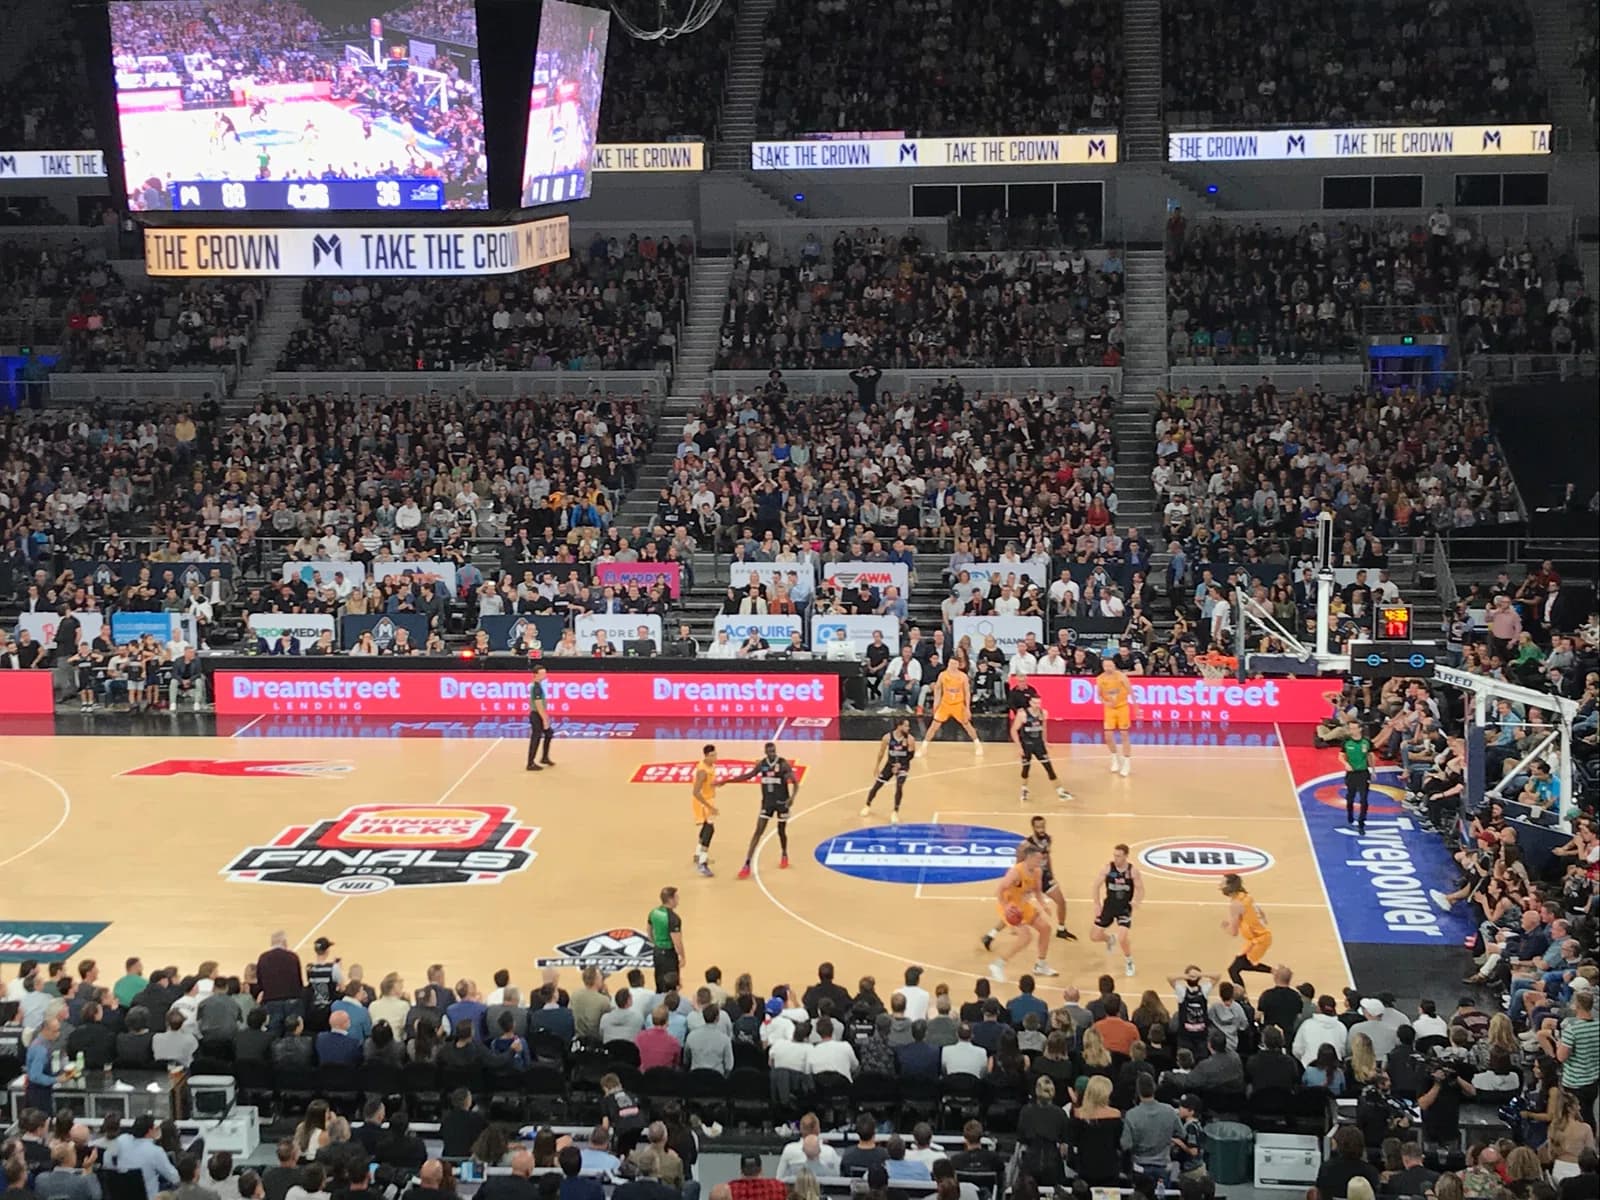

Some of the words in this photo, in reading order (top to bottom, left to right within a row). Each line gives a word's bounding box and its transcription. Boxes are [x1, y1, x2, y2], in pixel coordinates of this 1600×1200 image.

[945, 142, 977, 163] TAKE
[981, 141, 1004, 162] THE
[1009, 140, 1059, 161] CROWN
[1179, 137, 1202, 157] THE
[1207, 136, 1258, 157] CROWN
[1334, 133, 1367, 154] TAKE
[1373, 132, 1396, 153] THE
[1401, 131, 1454, 153] CROWN
[40, 154, 72, 175] TAKE
[75, 154, 99, 175] THE
[592, 148, 613, 168] KE
[616, 148, 639, 168] THE
[643, 146, 691, 168] CROWN
[759, 145, 789, 167] TAKE
[794, 144, 817, 166] THE
[820, 143, 870, 165] CROWN
[153, 234, 188, 270] THE
[196, 234, 280, 270] CROWN
[360, 234, 417, 270] TAKE
[423, 233, 466, 269] THE
[855, 573, 892, 583] AWM
[232, 675, 401, 699] Dreamstreet
[653, 677, 825, 701] Dreamstreet
[1070, 678, 1280, 707] Damstreet
[273, 701, 362, 711] LENDING
[481, 702, 570, 712] LENDNG
[694, 703, 785, 713] LENDING
[1135, 710, 1230, 720] ENDING
[360, 818, 480, 826] HUNGRY
[843, 841, 888, 853] La
[898, 841, 1017, 855] Trobe
[1169, 851, 1244, 866] NBL
[248, 849, 515, 869] FINALS
[1333, 817, 1445, 937] Tyrepower
[0, 933, 84, 944] INGS
[545, 959, 655, 967] MELBOURN
